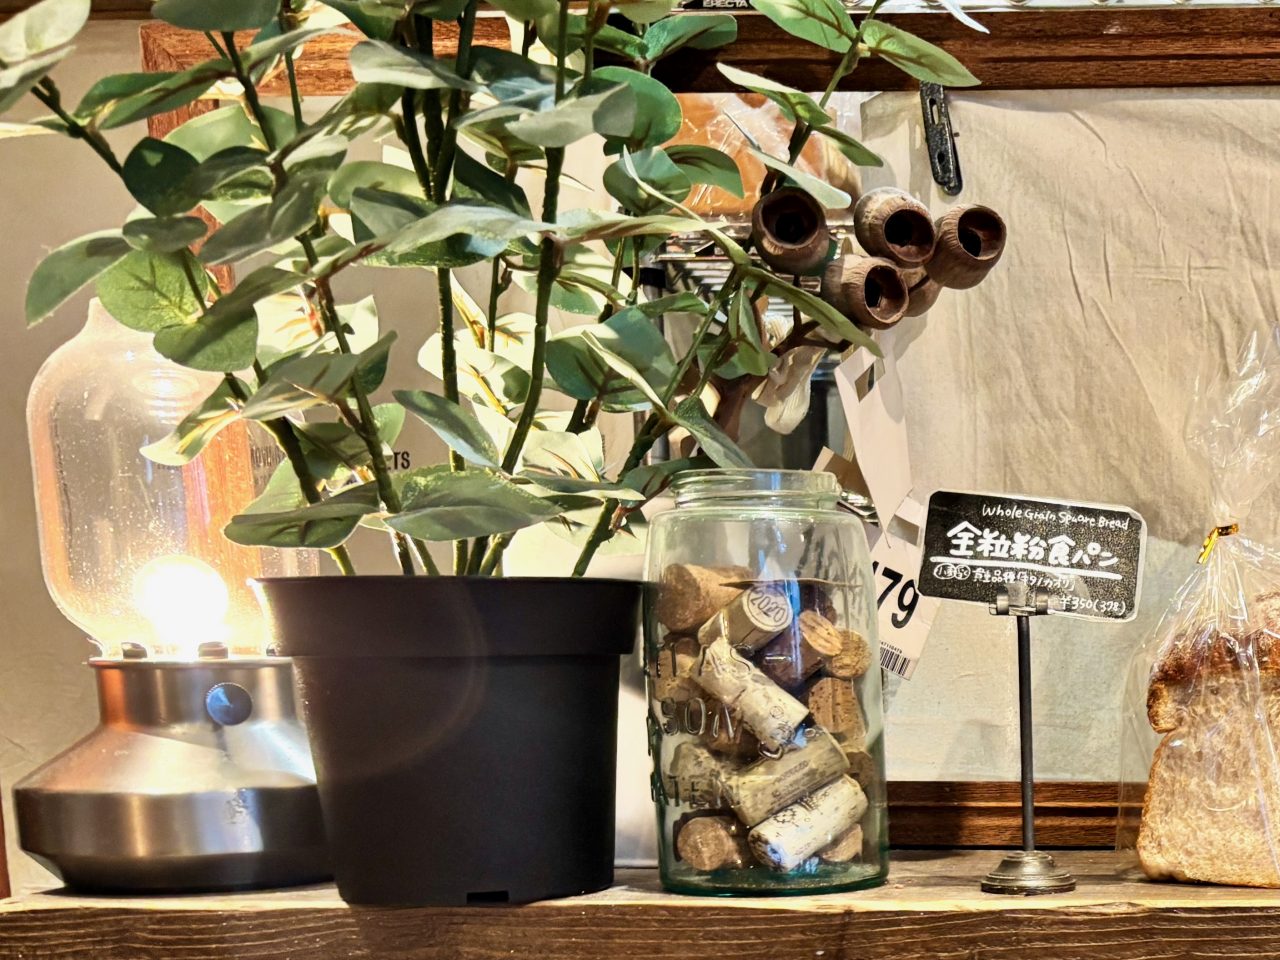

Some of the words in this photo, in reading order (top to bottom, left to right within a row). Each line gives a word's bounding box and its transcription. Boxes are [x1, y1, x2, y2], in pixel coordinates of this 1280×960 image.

[982, 504, 1022, 518] Whole
[1024, 509, 1056, 521] Grain
[1098, 515, 1131, 530] Bread
[946, 519, 1120, 567] 全粒粉食パン
[872, 561, 920, 629] 79
